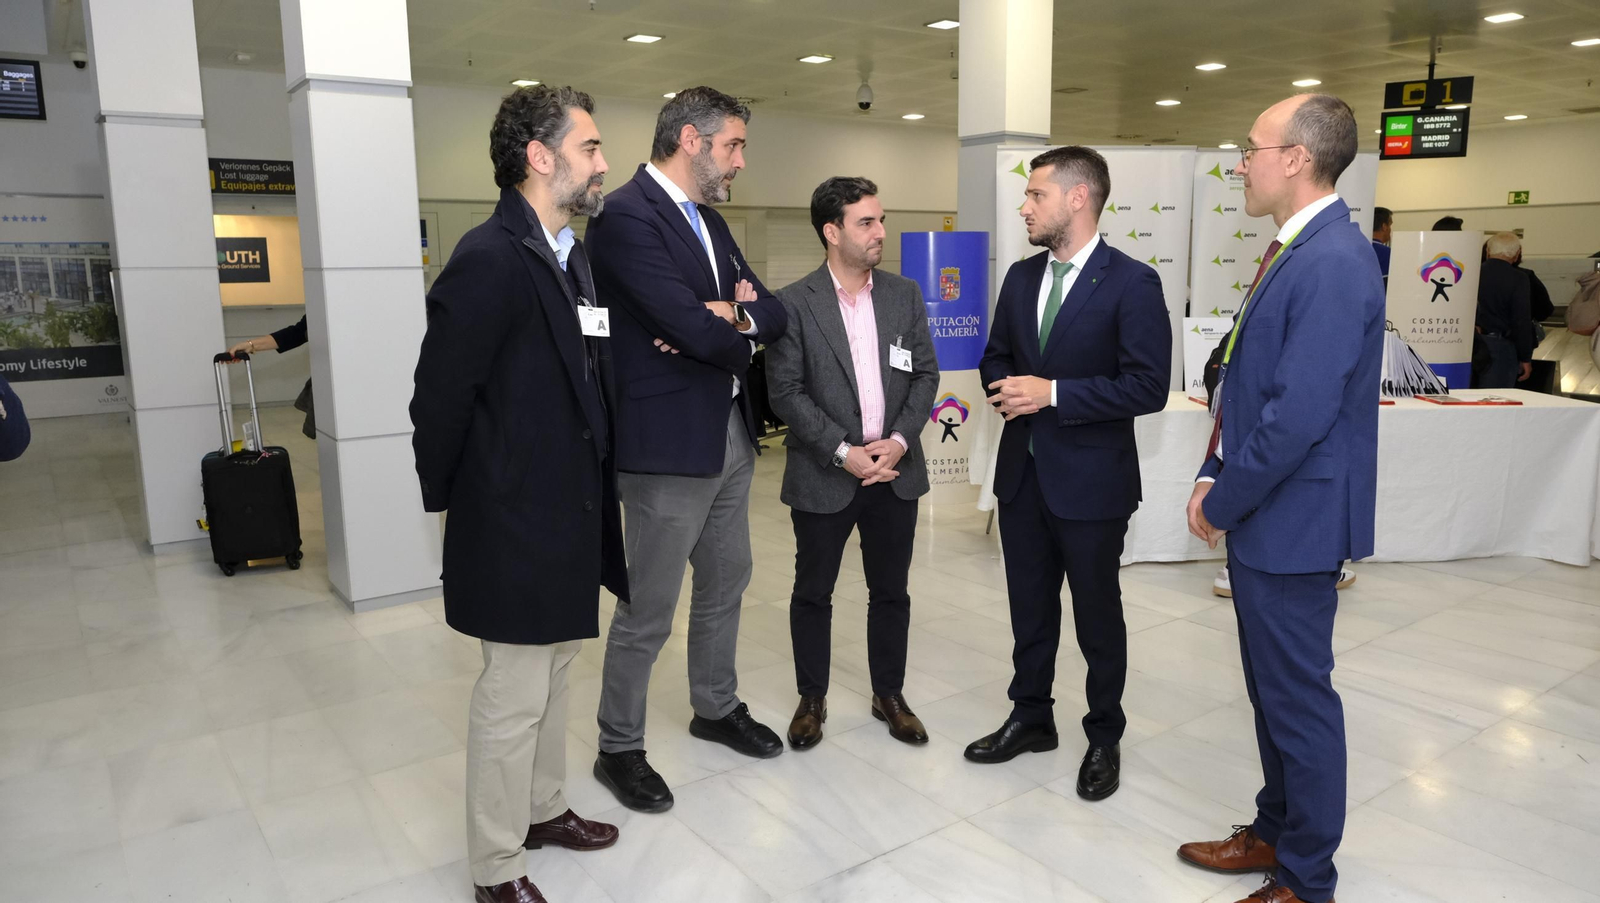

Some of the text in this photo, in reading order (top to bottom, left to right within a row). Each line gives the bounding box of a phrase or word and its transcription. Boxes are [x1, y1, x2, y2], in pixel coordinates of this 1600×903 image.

[3, 70, 33, 78] Baggages
[1442, 81, 1453, 103] 1
[1417, 115, 1457, 123] G.CANARIA
[219, 162, 291, 172] Verlorenes Gepäck
[239, 172, 269, 181] luggage
[221, 181, 296, 191] Equipajes extrav
[597, 319, 607, 331] A
[926, 314, 980, 327] PUTACIÓN
[933, 325, 979, 338] ALMERÍA
[1411, 326, 1459, 334] ALMERÍA
[0, 357, 88, 373] omy Lifestyle
[903, 359, 910, 368] A
